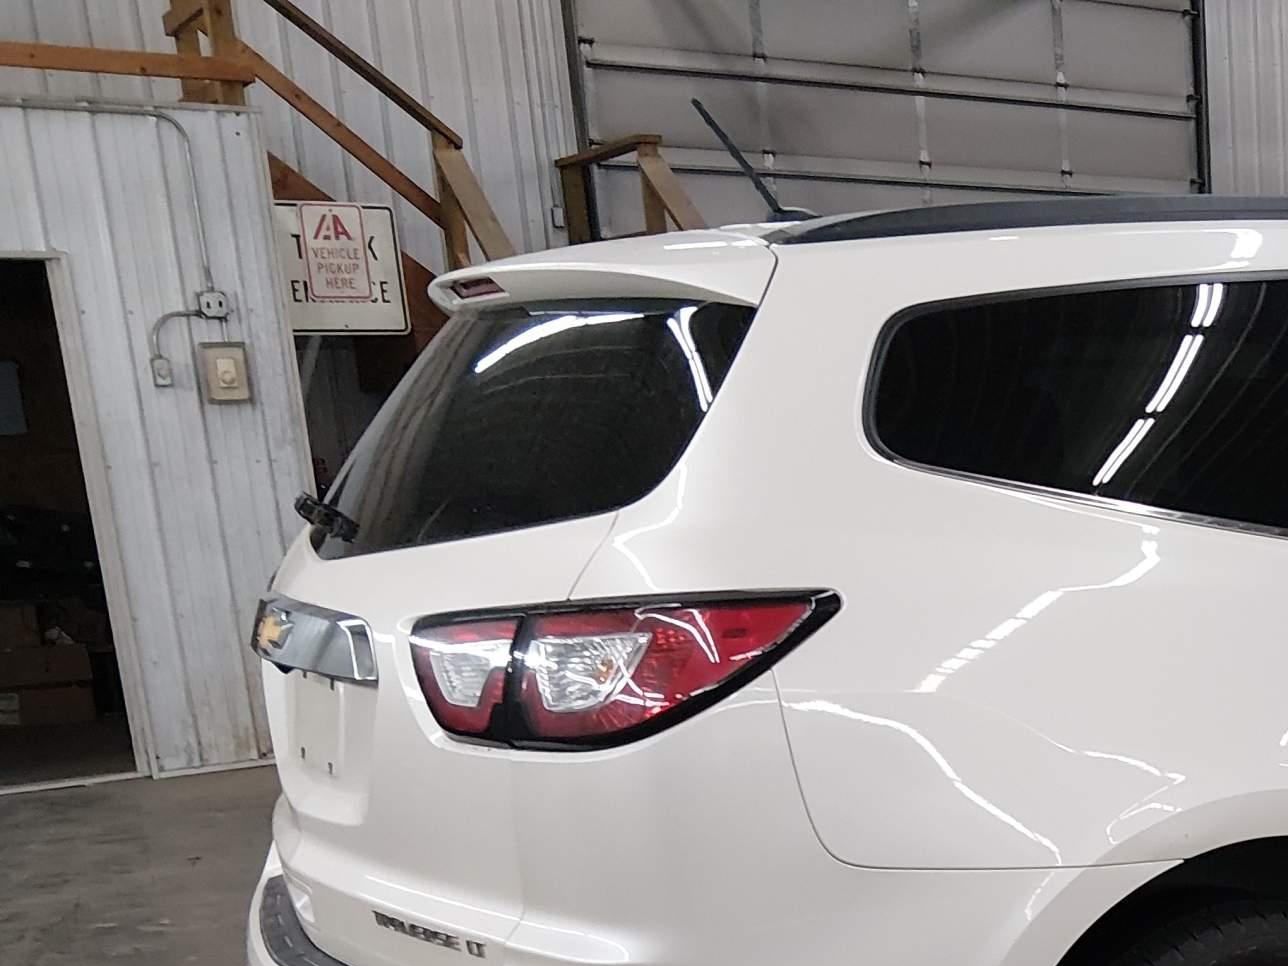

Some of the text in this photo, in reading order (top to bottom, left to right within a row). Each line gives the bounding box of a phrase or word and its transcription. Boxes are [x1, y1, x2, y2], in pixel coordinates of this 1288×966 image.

[312, 247, 360, 260] VEHICLE
[317, 262, 359, 274] PICKUP
[325, 277, 356, 289] HERE
